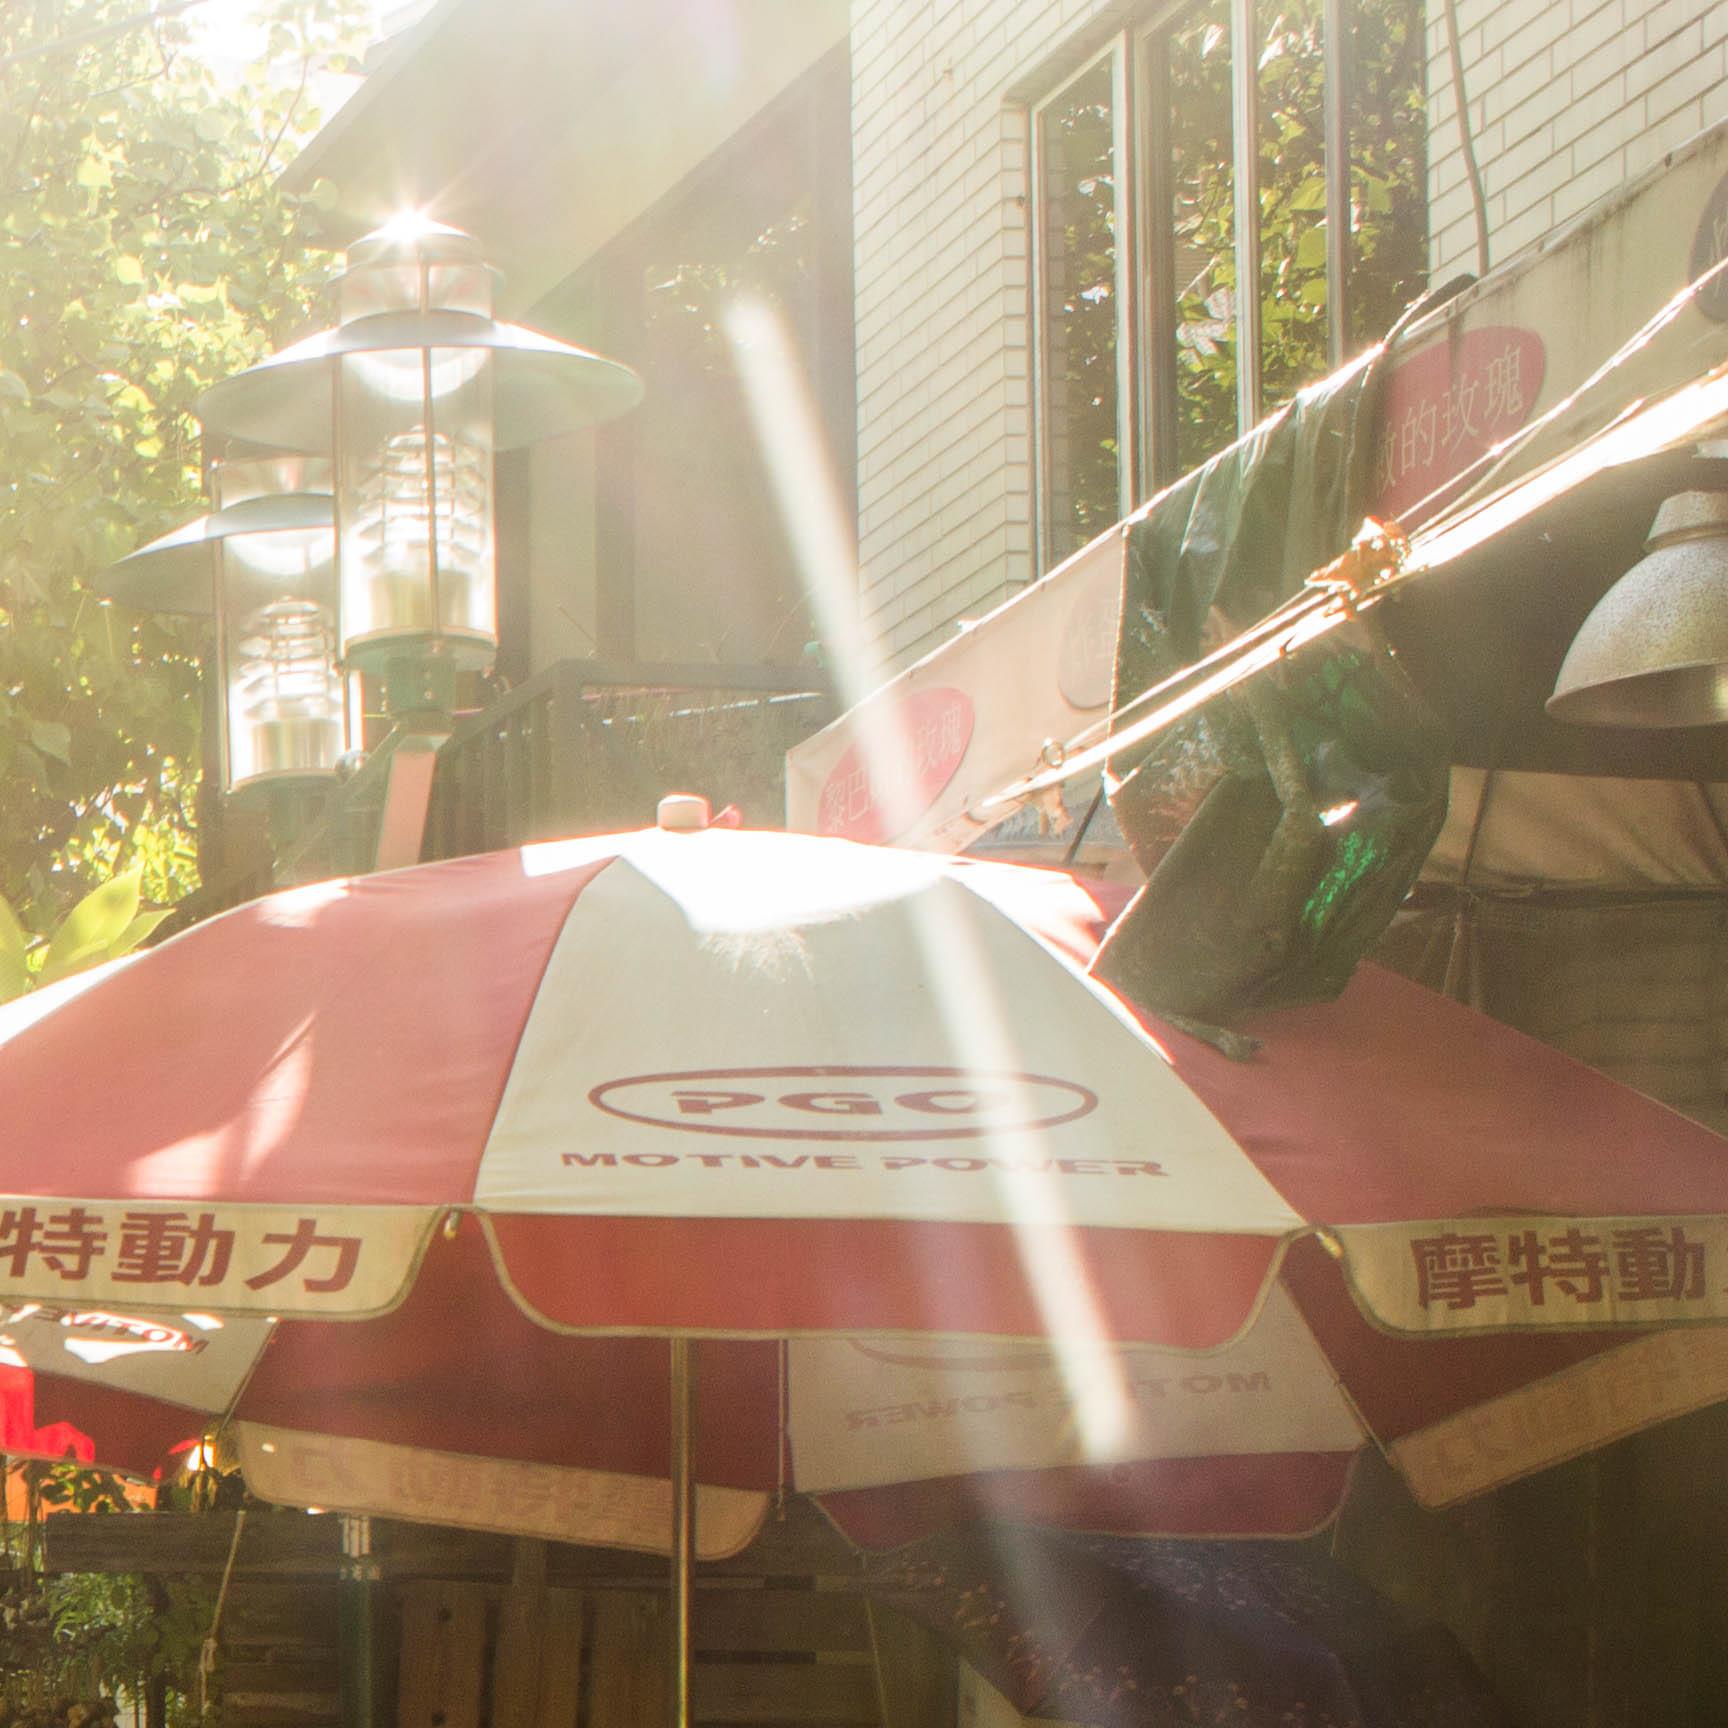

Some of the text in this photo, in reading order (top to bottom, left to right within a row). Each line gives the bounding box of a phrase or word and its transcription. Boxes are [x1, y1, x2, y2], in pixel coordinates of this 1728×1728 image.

[560, 1151, 864, 1170] MOTIVE
[1409, 1226, 1728, 1309] 摩特動
